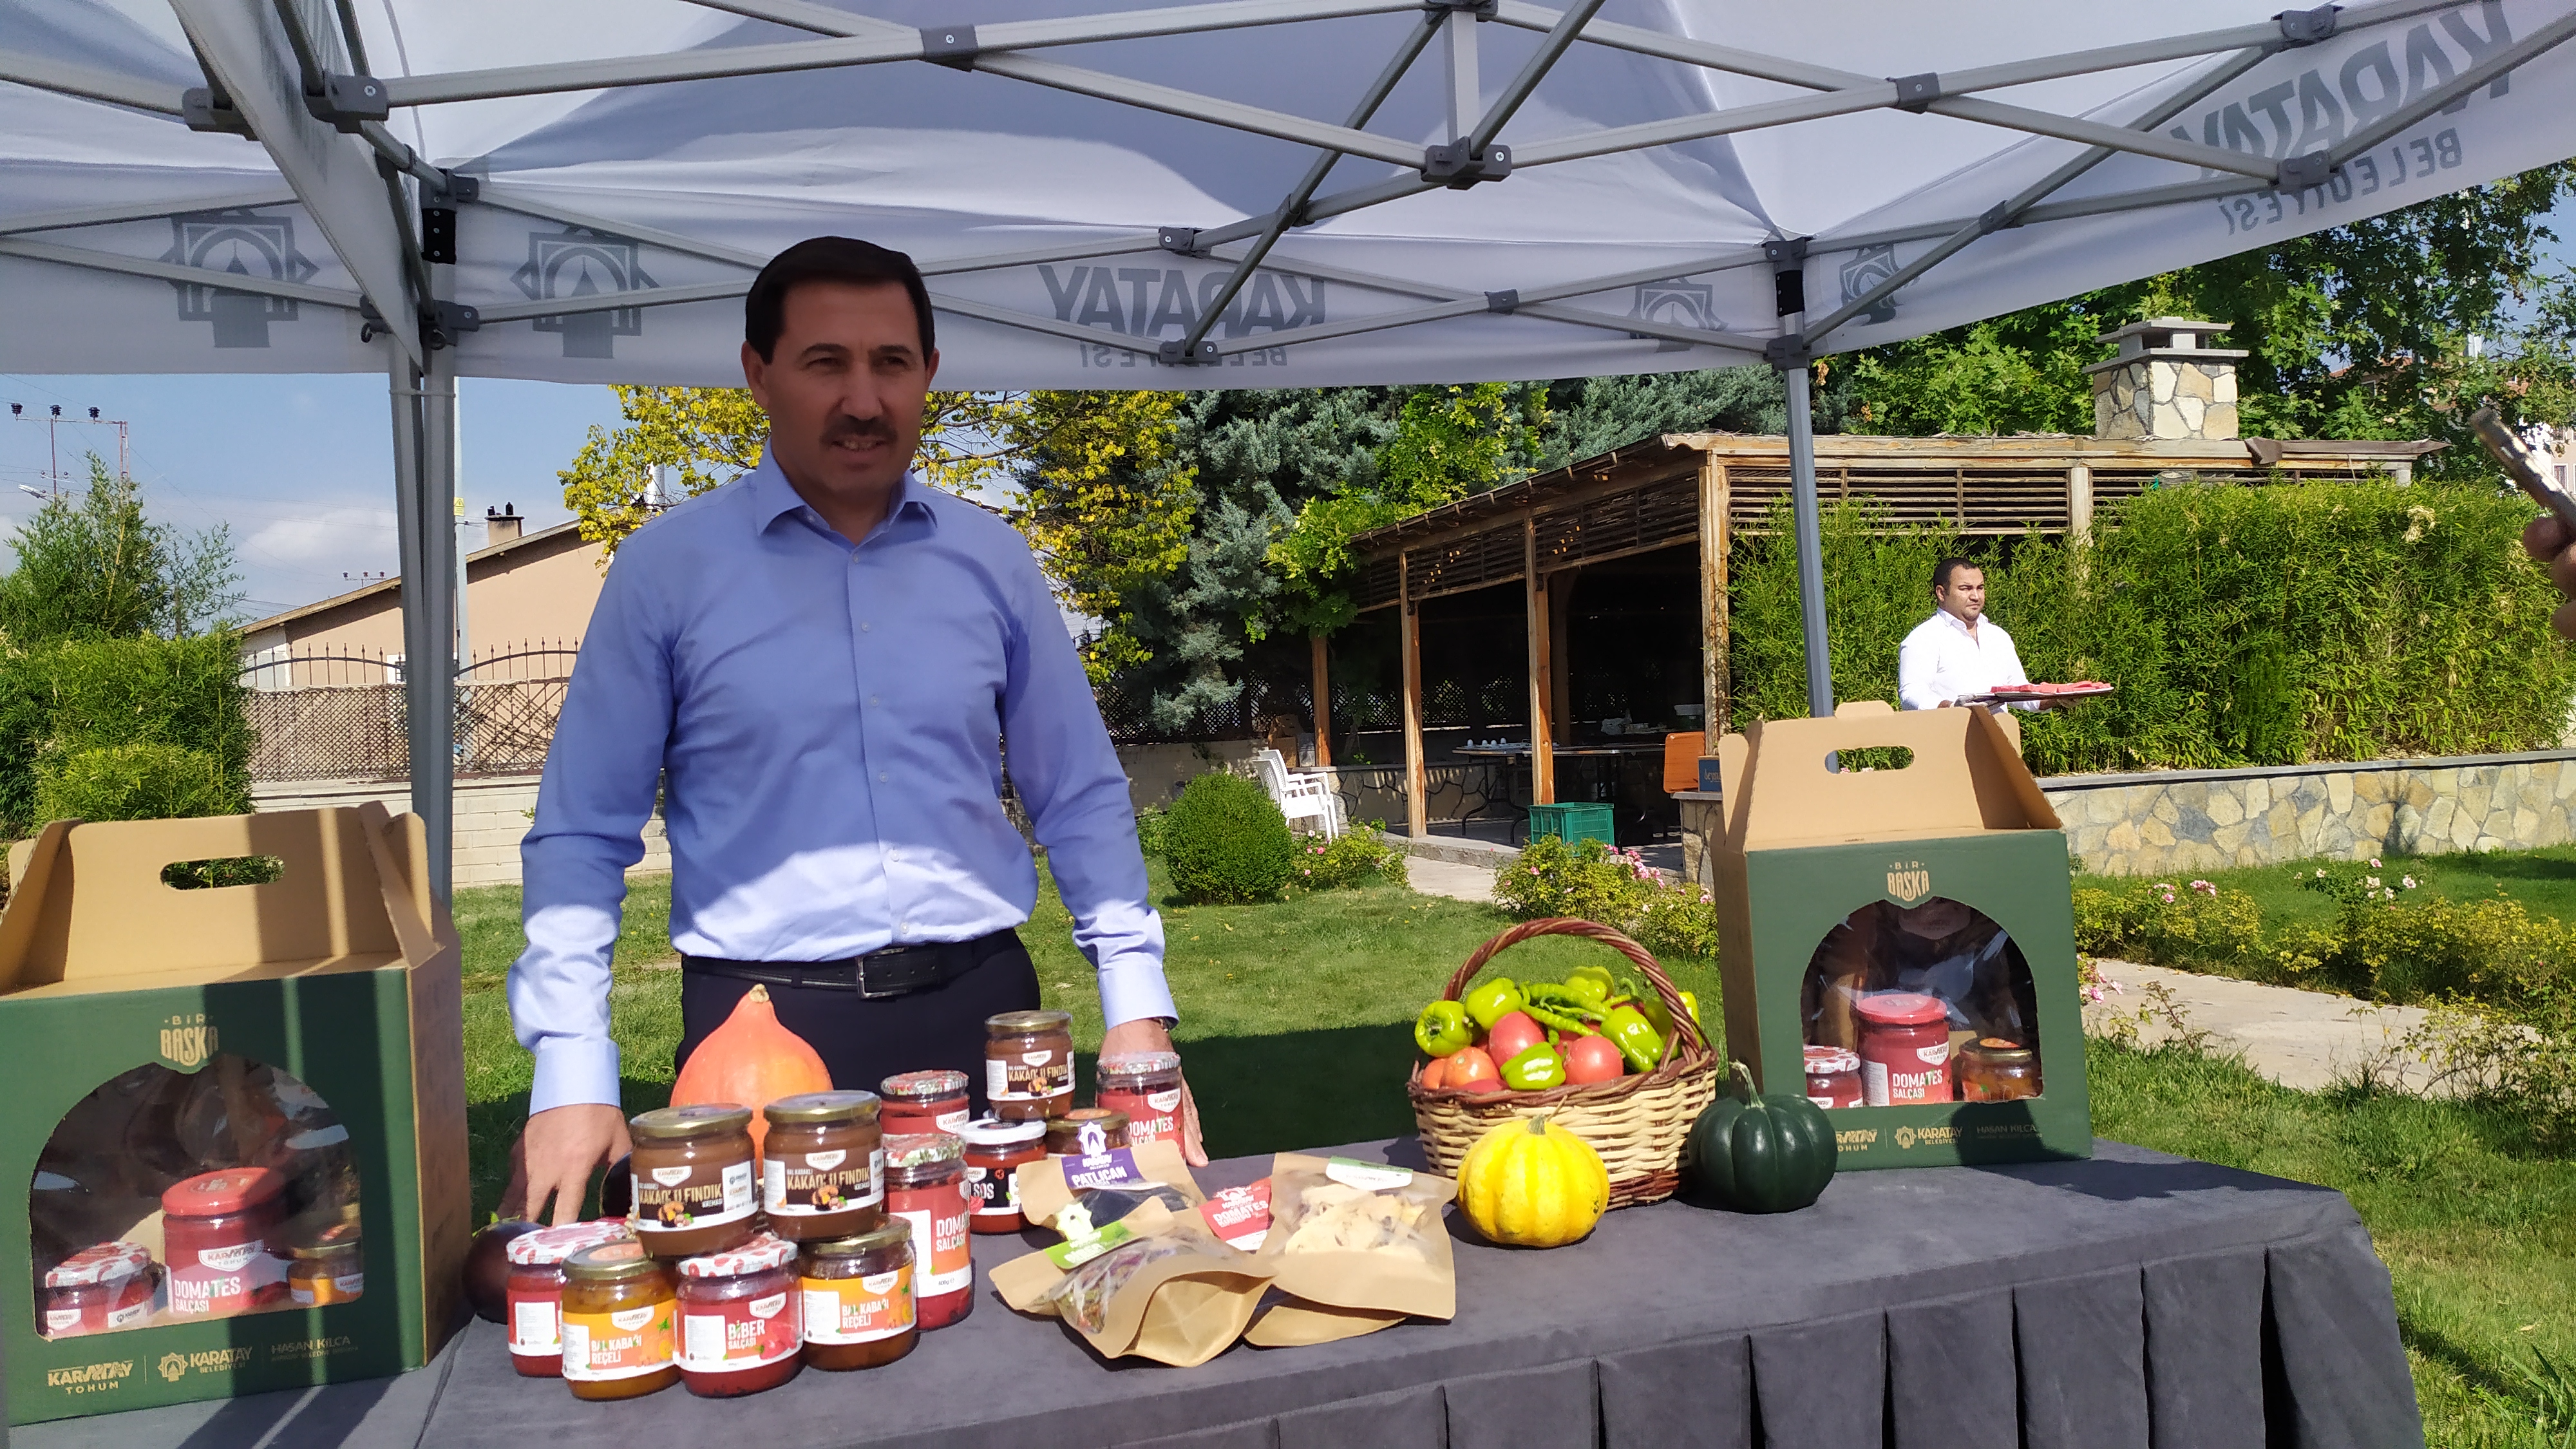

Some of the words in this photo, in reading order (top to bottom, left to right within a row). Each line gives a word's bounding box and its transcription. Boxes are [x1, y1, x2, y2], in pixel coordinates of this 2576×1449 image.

[1892, 1069, 1943, 1088] DOMATES
[1893, 1088, 1925, 1100] SALÇASI
[1918, 1126, 1963, 1139] KARATAY
[1837, 1144, 1868, 1152] OHUM
[839, 1167, 869, 1186] FINDIK
[1072, 1166, 1128, 1187] PATLICAN
[684, 1184, 722, 1204] FINDIK
[974, 1183, 994, 1200] SOS
[1213, 1200, 1269, 1222] DOMATES
[936, 1233, 965, 1252] SALÇASI
[174, 1276, 242, 1300] DOMATES
[175, 1298, 209, 1314] SALÇASI
[728, 1320, 765, 1340] BİBER
[270, 1340, 314, 1354] HASAN
[728, 1337, 756, 1350] SALÇASI
[190, 1347, 252, 1368] KARATAY
[65, 1381, 118, 1396] TOHUM
